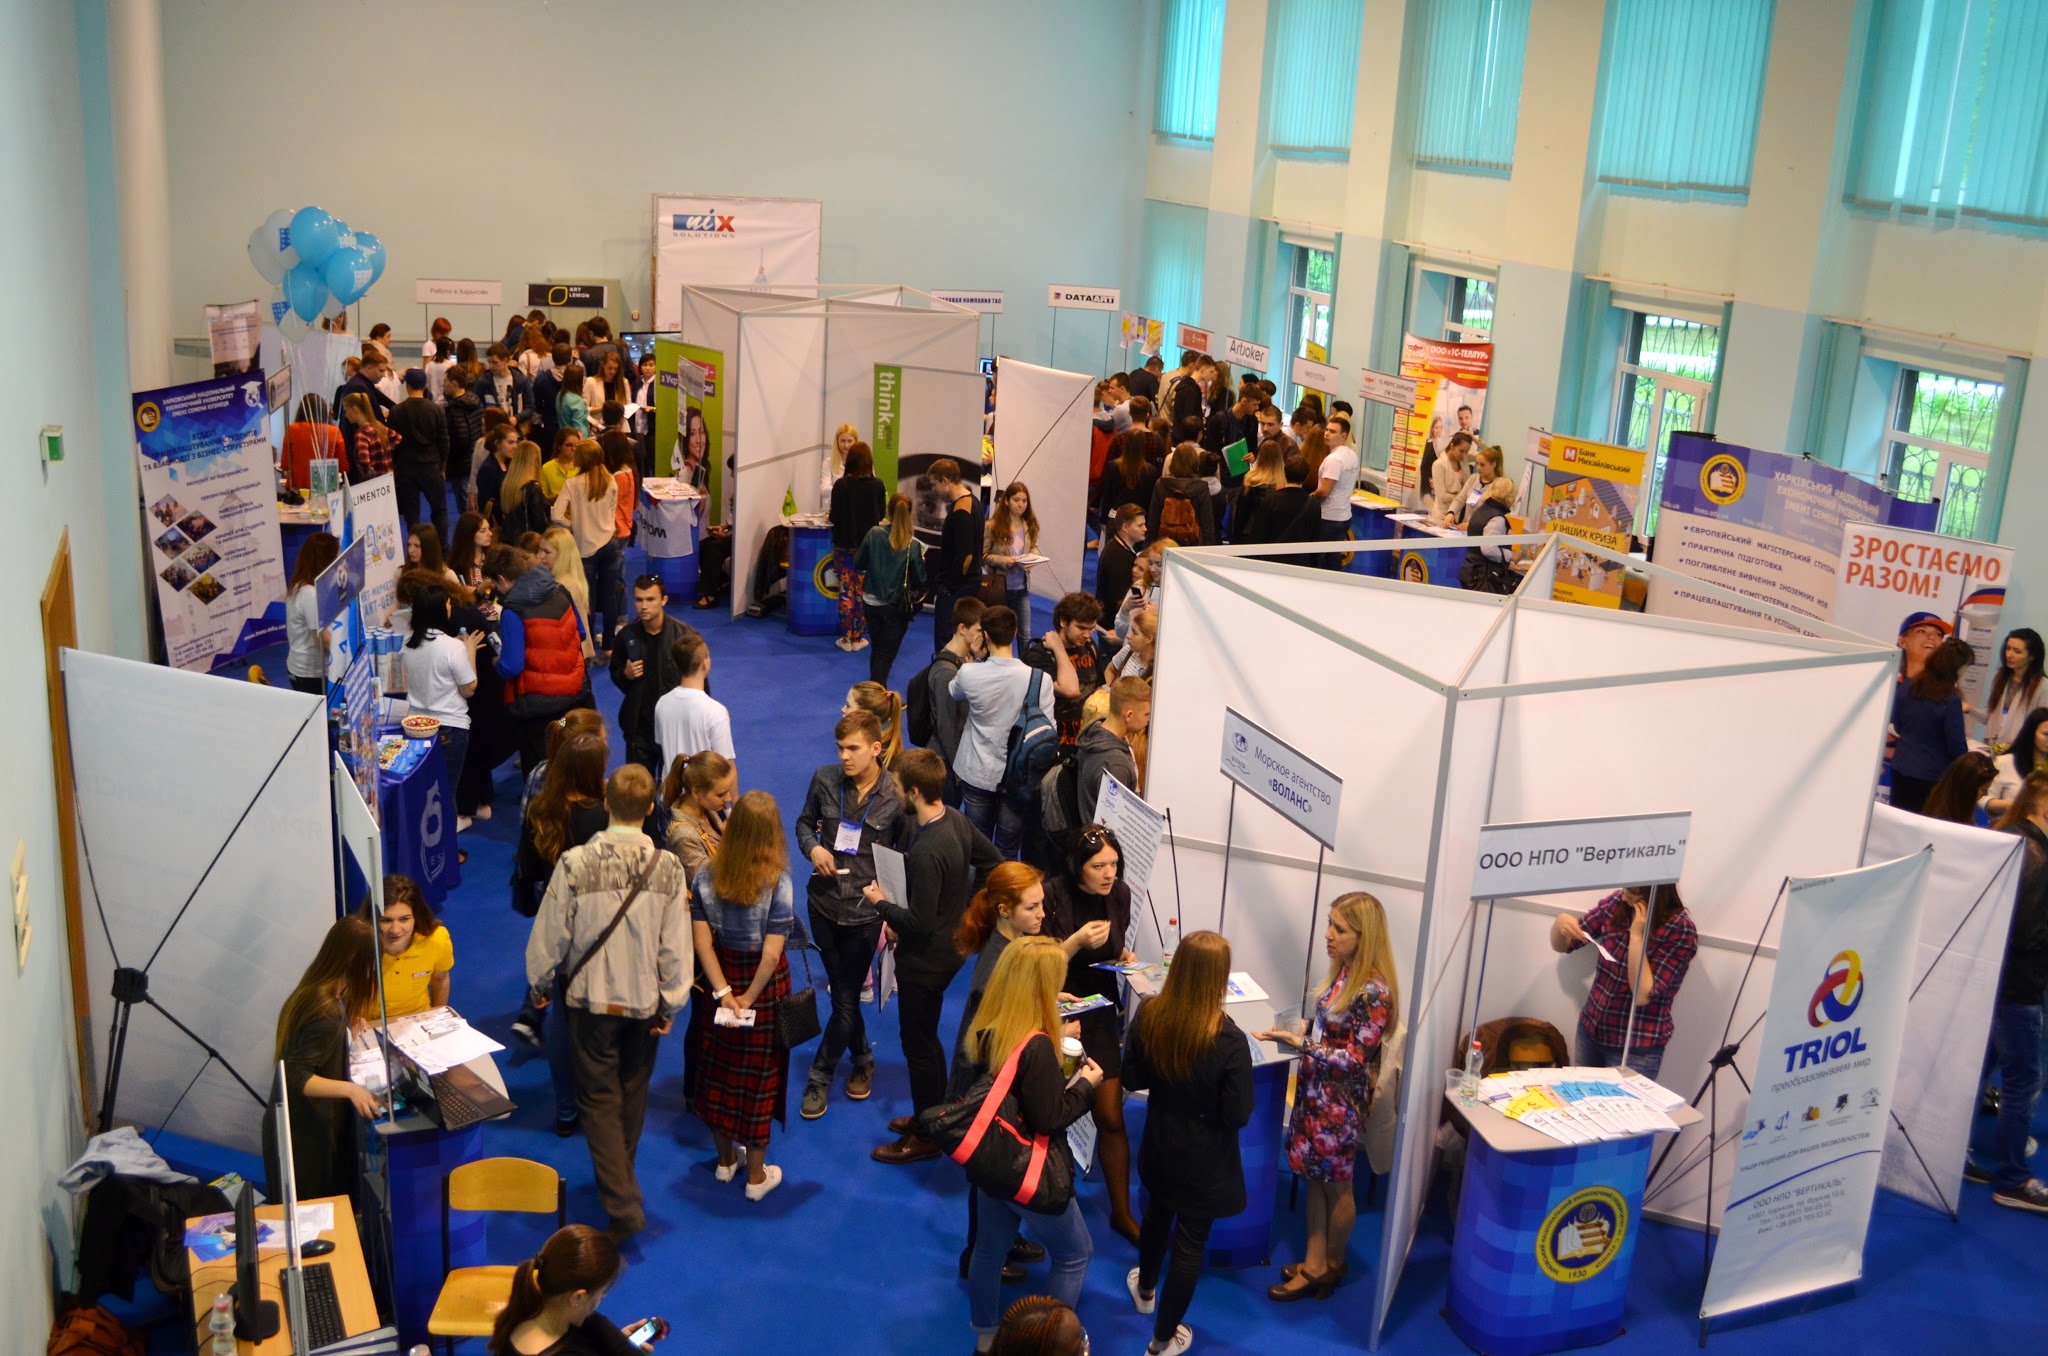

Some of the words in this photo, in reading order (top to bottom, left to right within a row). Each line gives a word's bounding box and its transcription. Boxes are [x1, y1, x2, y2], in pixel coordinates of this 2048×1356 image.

[459, 288, 488, 296] Харькове
[1430, 346, 1447, 355] ООО
[878, 371, 896, 424] think
[877, 424, 886, 440] fast
[885, 425, 893, 450] global
[143, 464, 152, 472] ТА
[1577, 457, 1631, 474] Михайлівський
[1578, 448, 1597, 459] Банк
[1774, 471, 1833, 498] ХАРКІВСЬКИЙ
[1775, 486, 1837, 511] ЕКОНОМІЧНИЙ
[1783, 500, 1811, 517] ІМЕНІ
[1552, 522, 1558, 532] У
[1559, 524, 1588, 540] ІНШИХ
[1589, 532, 1618, 546] КРИЗА
[1690, 526, 1752, 546] ЄВРОПЕЙСЬКИЙ
[1757, 541, 1811, 564] МАГІСТЕРСЬКИЙ
[1687, 541, 1734, 558] ПРАКТИЧНА
[1737, 553, 1783, 572] ПІДГОТОВКА
[1850, 535, 2001, 582] ЗРОСТАЄМО
[1685, 558, 1737, 577] ПОГЛИБЛЕНЕ
[1738, 571, 1776, 588] ВИВЧЕННЯ
[1779, 584, 1814, 602] ІНОЗЕМНИХ
[1816, 598, 1828, 609] МОВ
[1845, 561, 1941, 599] РАЗОМ!
[1680, 591, 1762, 618] ПРАЦЕВЛАШТУВАННЯ
[1763, 613, 1772, 622] ТА
[1773, 616, 1801, 634] УСПІШНА
[1254, 746, 1290, 780] Морское
[1290, 771, 1332, 805] агентство
[1268, 777, 1313, 814] «ВОЛАНС»
[1479, 851, 1523, 870] ООО
[1528, 847, 1570, 867] НПО
[1575, 839, 1686, 866] "Вертикаль"
[1784, 1027, 1867, 1074] TRIOL
[1770, 1062, 1852, 1093] преобразовываем
[1852, 1057, 1871, 1072] мир
[1752, 1198, 1772, 1209] ООО
[1773, 1191, 1791, 1202] НПО
[1792, 1176, 1846, 1196] "ВЕРТИКАЛЬ"
[1568, 1269, 1587, 1279] 1930
